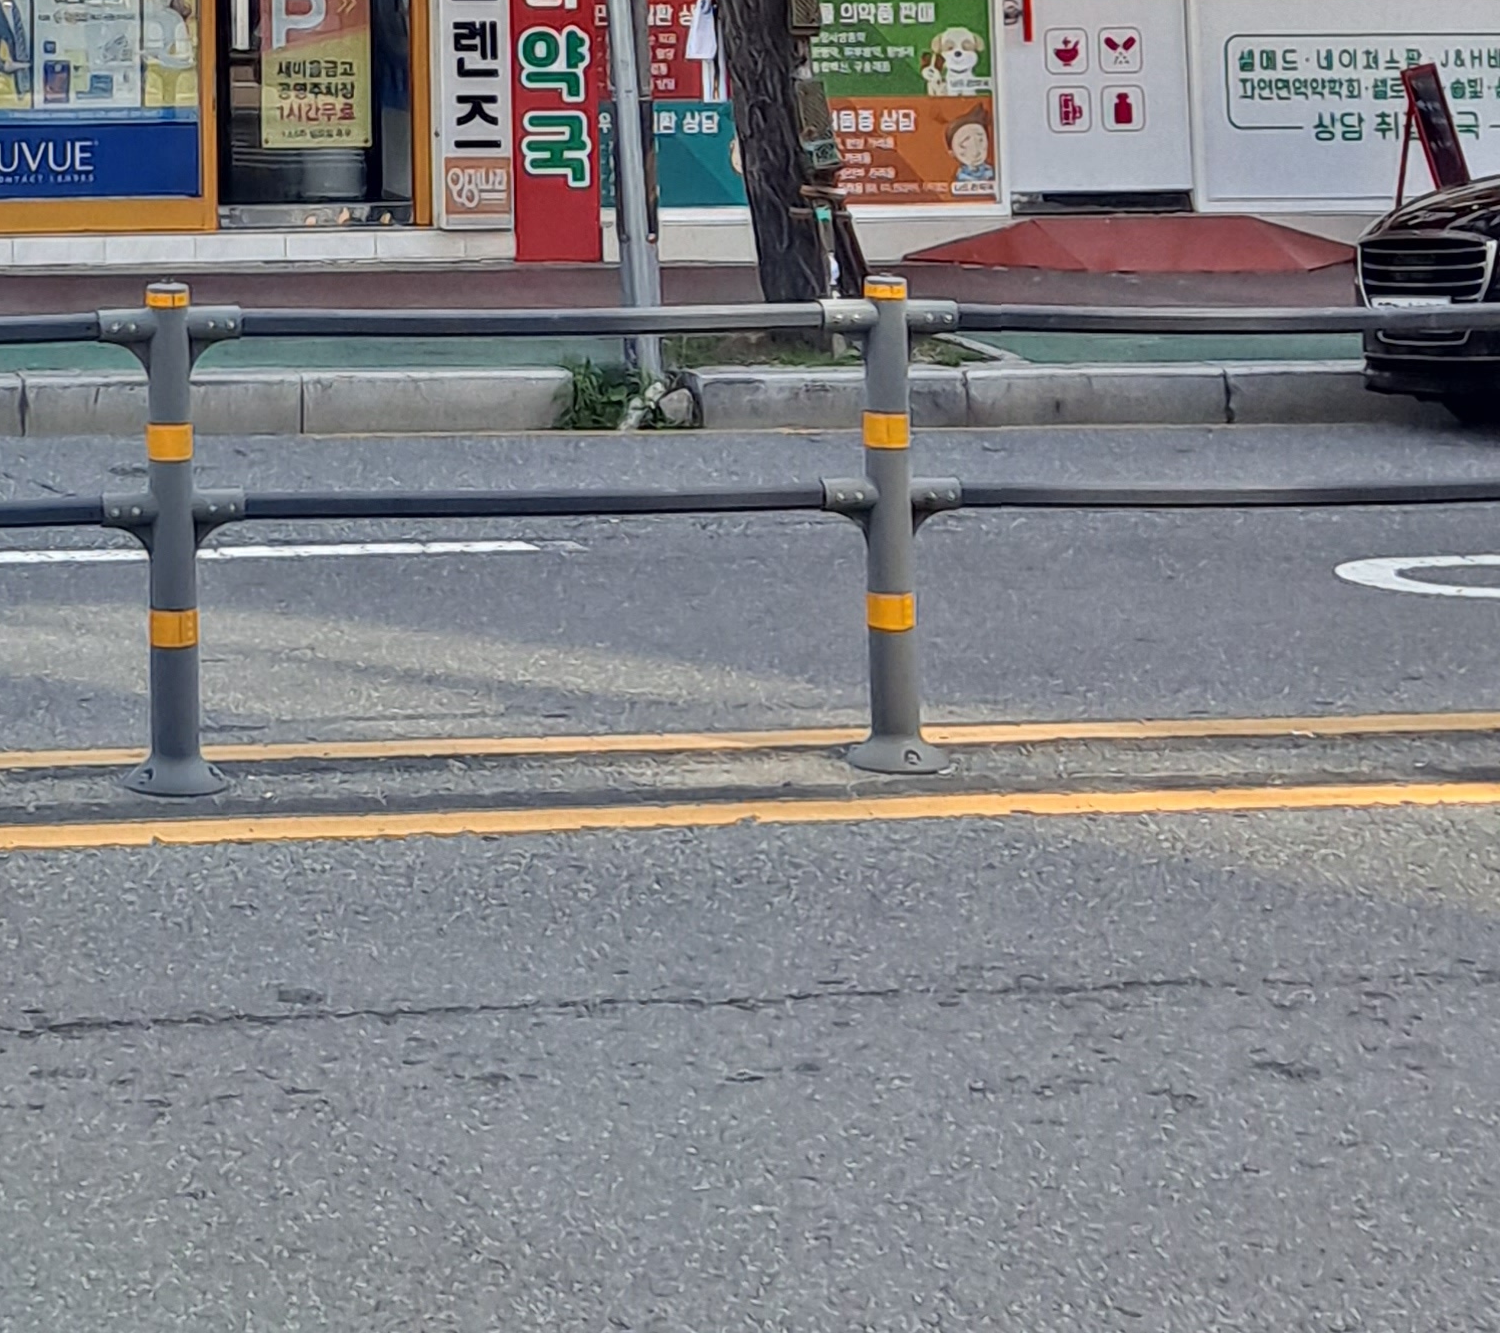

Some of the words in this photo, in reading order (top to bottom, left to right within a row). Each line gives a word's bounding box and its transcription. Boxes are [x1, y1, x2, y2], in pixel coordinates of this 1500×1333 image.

[840, 2, 894, 25] 의약품
[900, 2, 936, 24] 판매
[277, 60, 355, 78] 새마을금고
[277, 81, 355, 100] 공영주차장
[276, 102, 356, 122] 1시간무료
[683, 111, 719, 134] 상담
[880, 110, 916, 131] 상담
[1313, 111, 1365, 142] 상담
